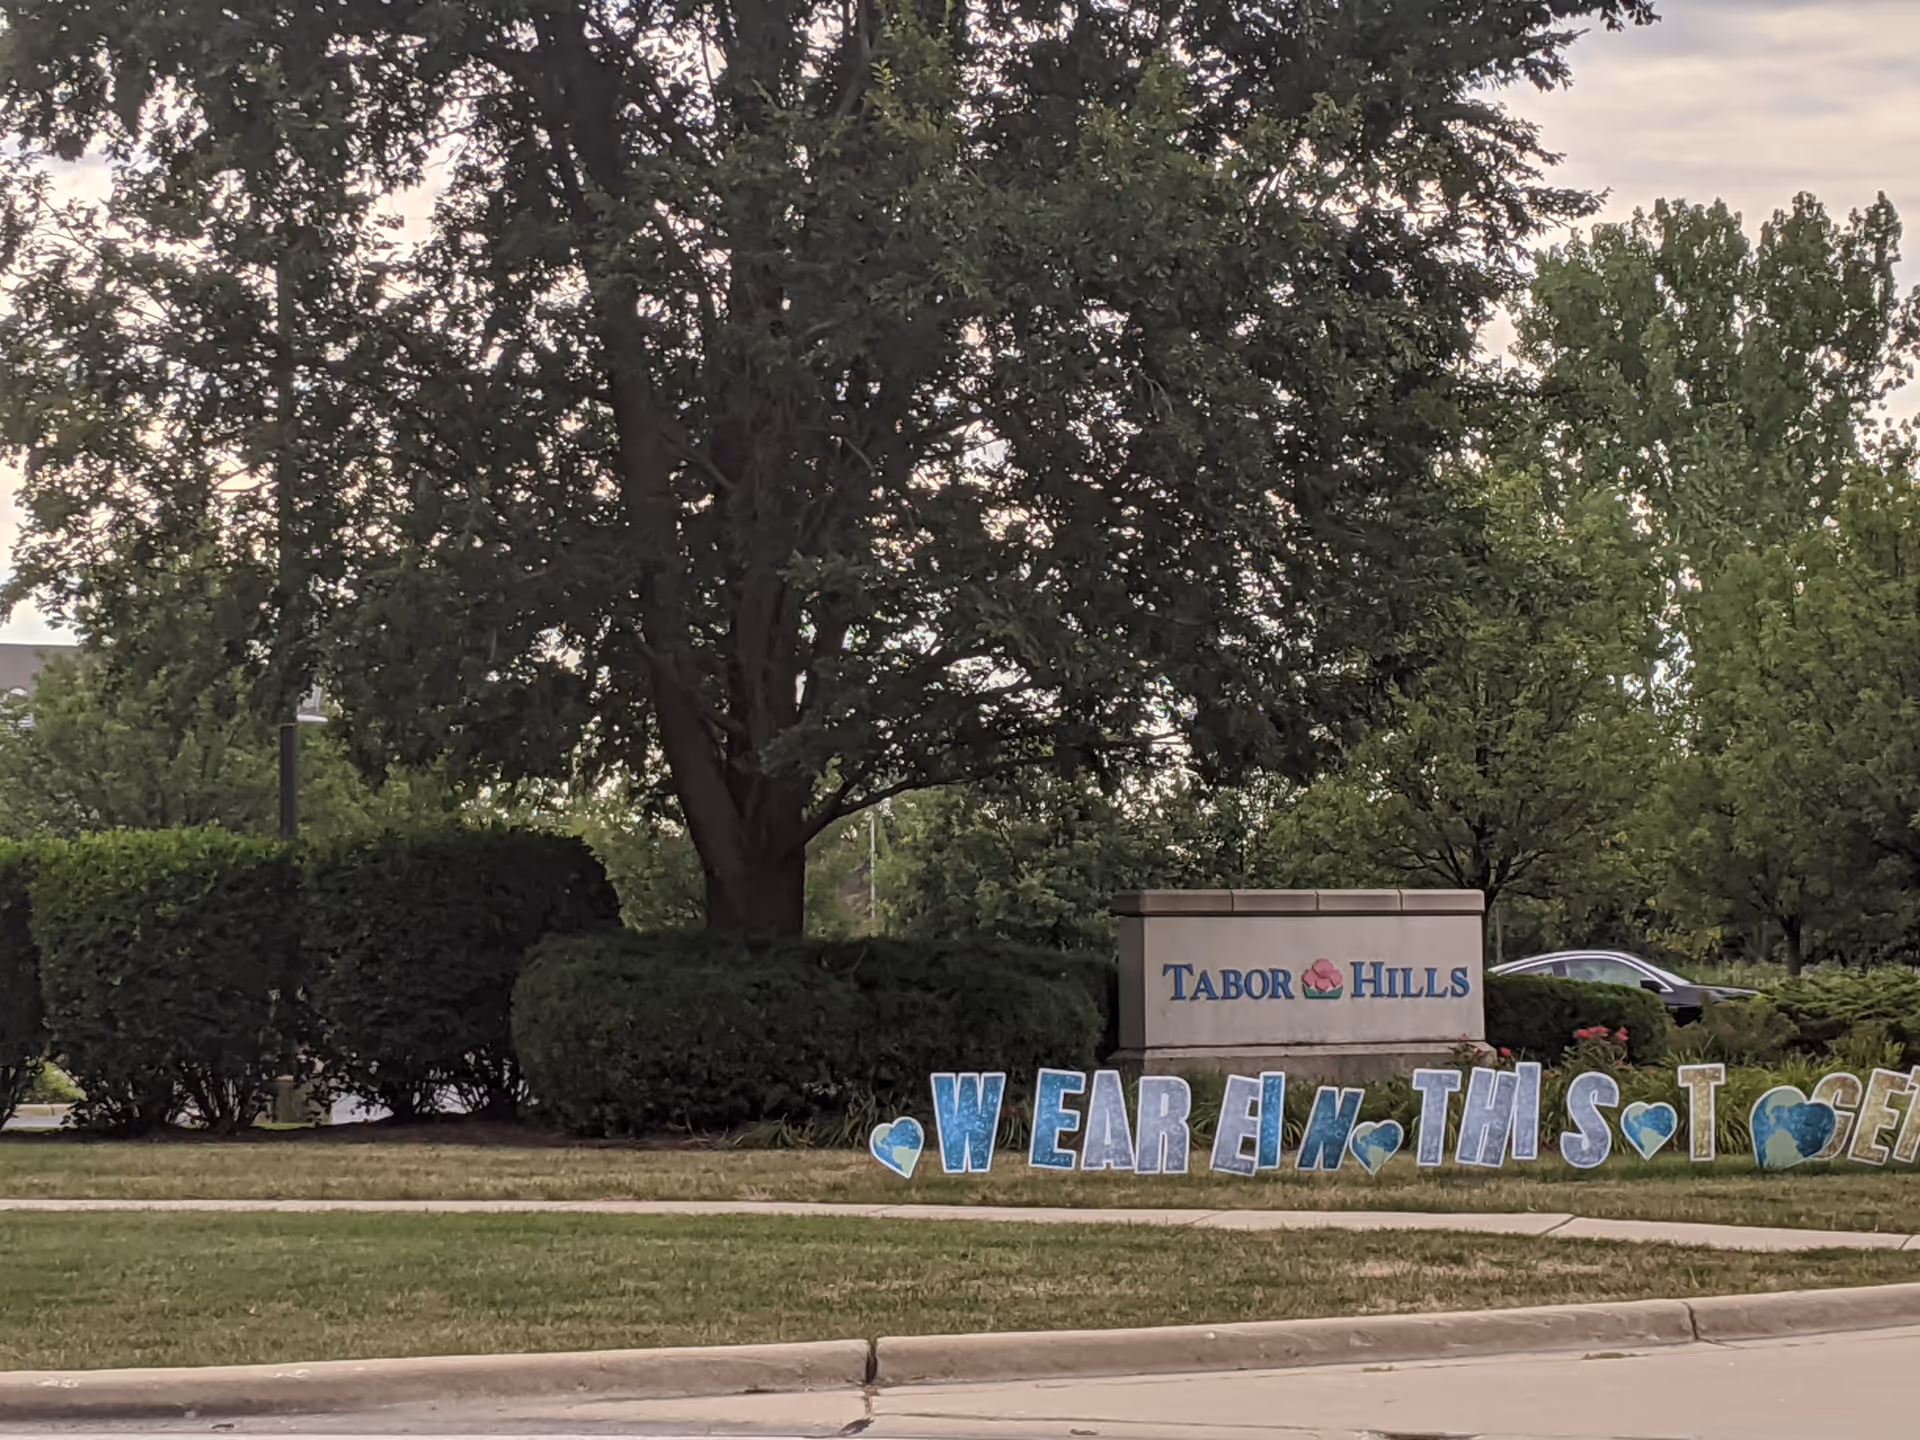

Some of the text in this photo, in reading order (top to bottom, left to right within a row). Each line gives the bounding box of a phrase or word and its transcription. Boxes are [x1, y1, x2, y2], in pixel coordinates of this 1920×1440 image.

[1162, 960, 1471, 1000] TABOR HILLS
[930, 1061, 1920, 1177] WE ARE IN THIS TGE
